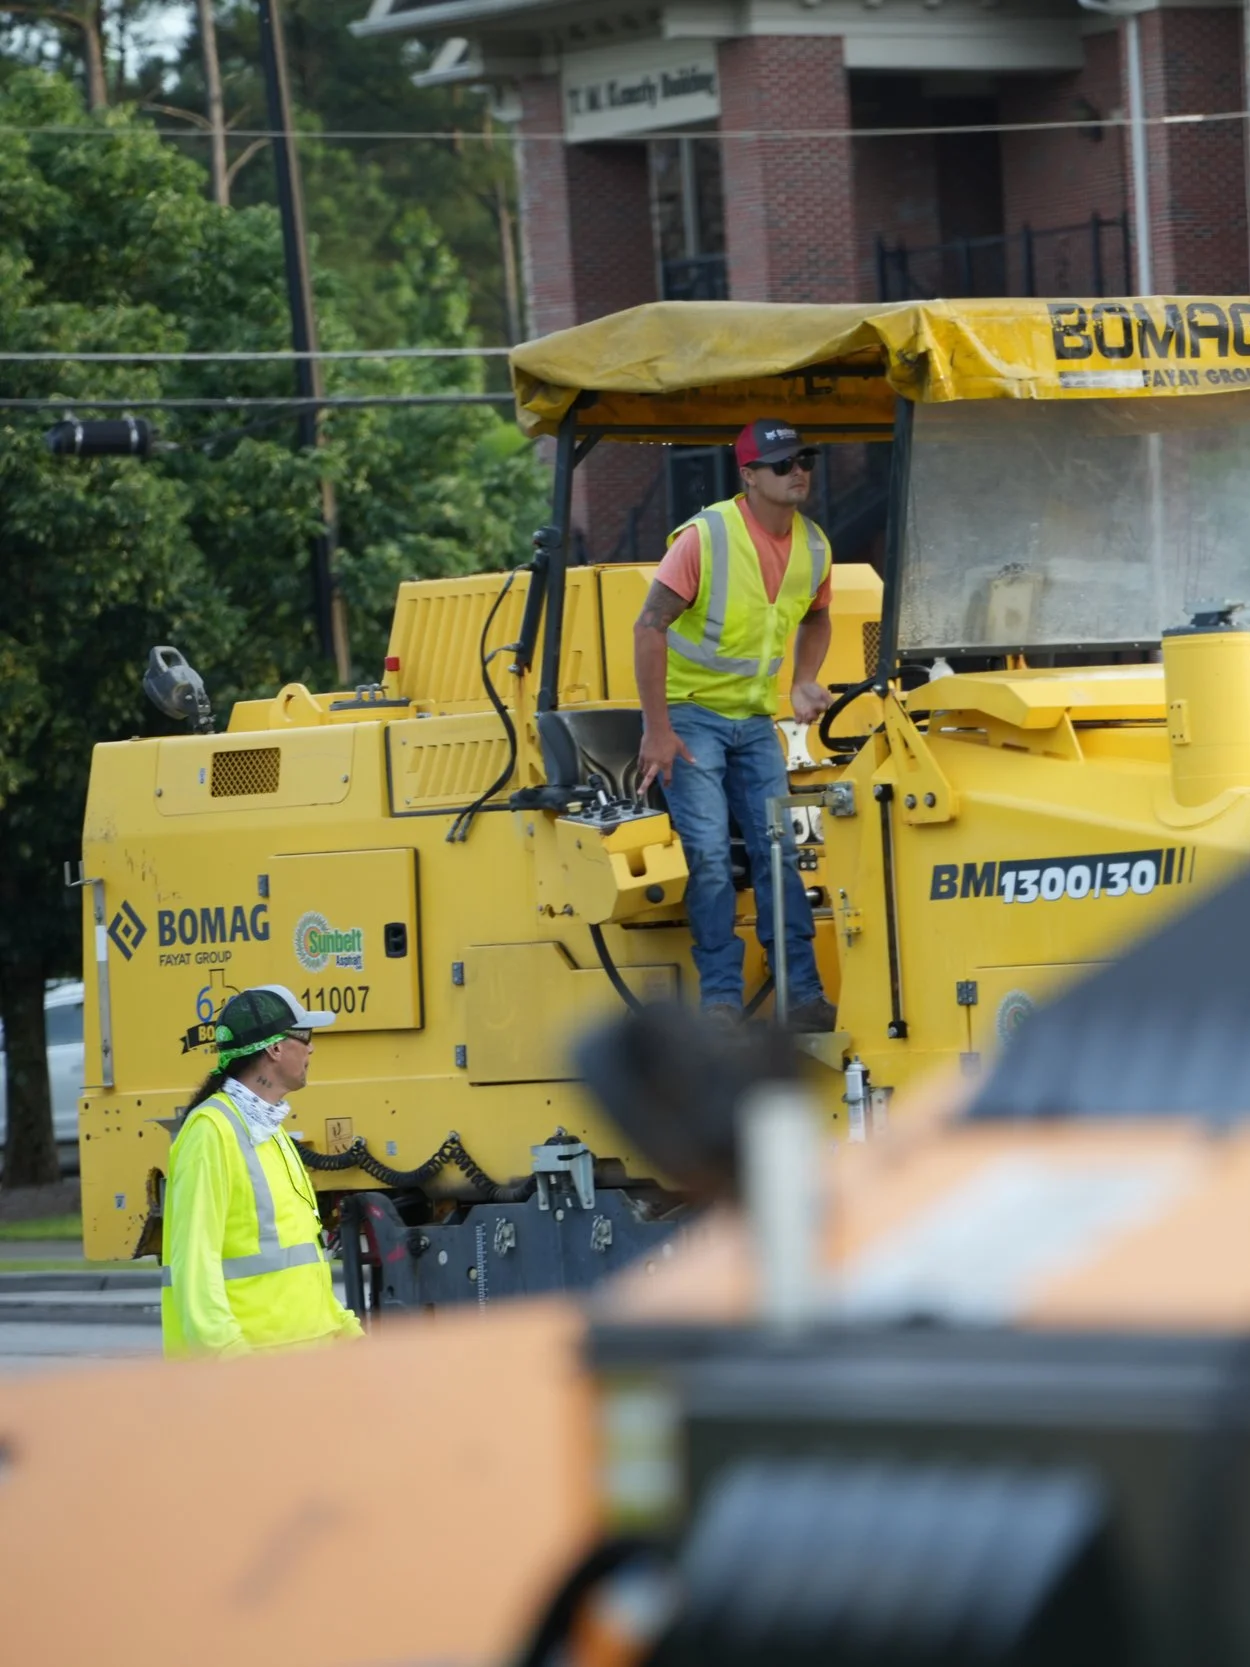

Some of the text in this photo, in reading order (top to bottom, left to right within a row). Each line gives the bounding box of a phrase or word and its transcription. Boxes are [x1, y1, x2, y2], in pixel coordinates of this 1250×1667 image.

[1142, 369, 1200, 387] FAYAT
[158, 904, 270, 947] BOMAG
[309, 928, 362, 954] Sunbelt
[159, 950, 232, 967] FAYAT GROUP
[301, 985, 370, 1014] 11007
